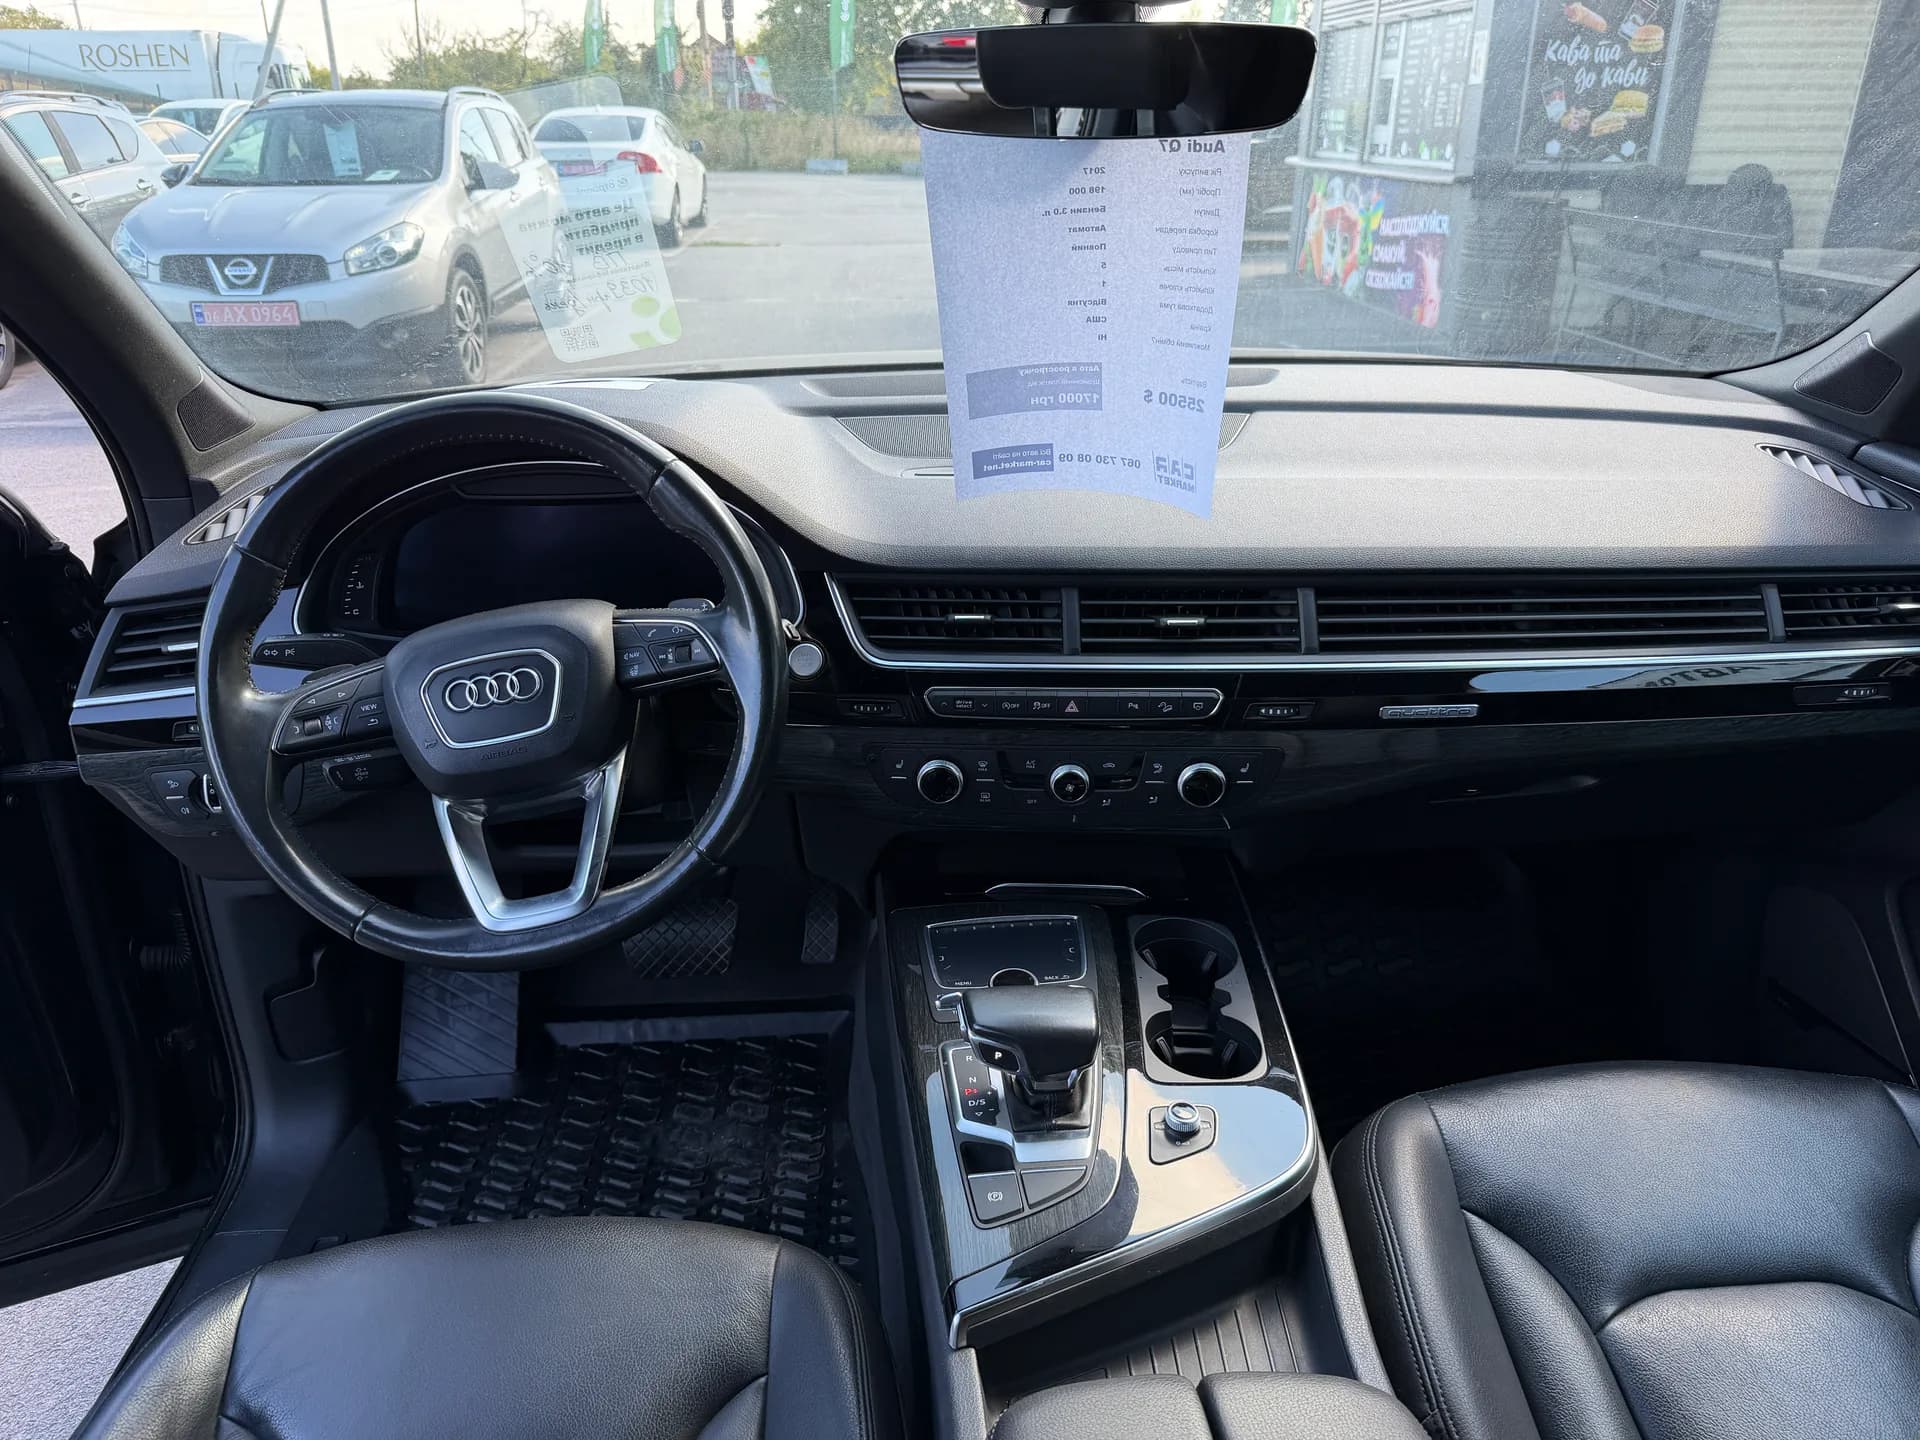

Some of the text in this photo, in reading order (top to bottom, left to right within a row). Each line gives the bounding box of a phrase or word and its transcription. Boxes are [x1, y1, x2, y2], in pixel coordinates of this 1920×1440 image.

[1544, 34, 1590, 66] Кава
[79, 44, 189, 72] ROSHEN
[1601, 59, 1650, 88] кави
[223, 306, 247, 322] AX
[251, 306, 292, 323] 0964
[361, 703, 378, 712] VIEW
[1388, 707, 1472, 717] quattro
[994, 1051, 1002, 1060] P
[969, 1076, 977, 1084] N
[968, 1099, 986, 1107] D/S
